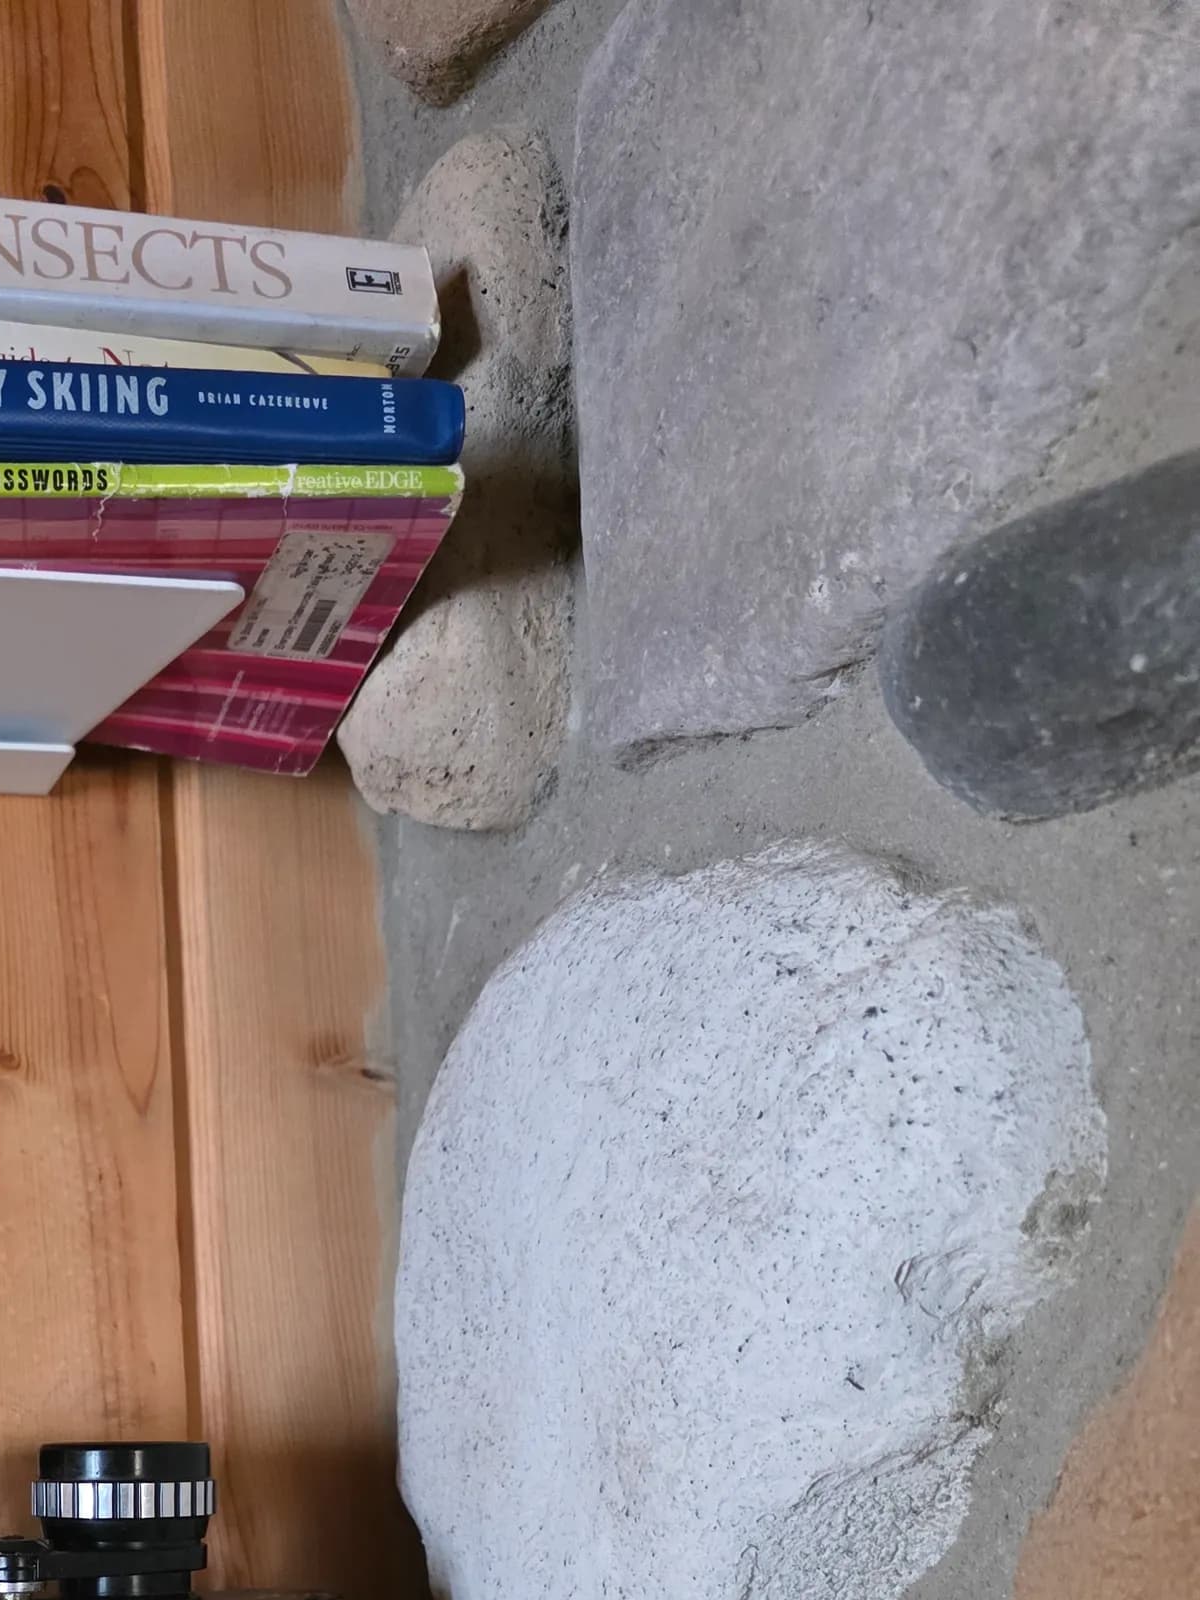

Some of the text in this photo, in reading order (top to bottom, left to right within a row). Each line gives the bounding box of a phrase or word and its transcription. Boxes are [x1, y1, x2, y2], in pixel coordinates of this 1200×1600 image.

[27, 370, 168, 416] SKIING
[198, 391, 241, 405] BRIAN
[381, 384, 396, 434] NORTON
